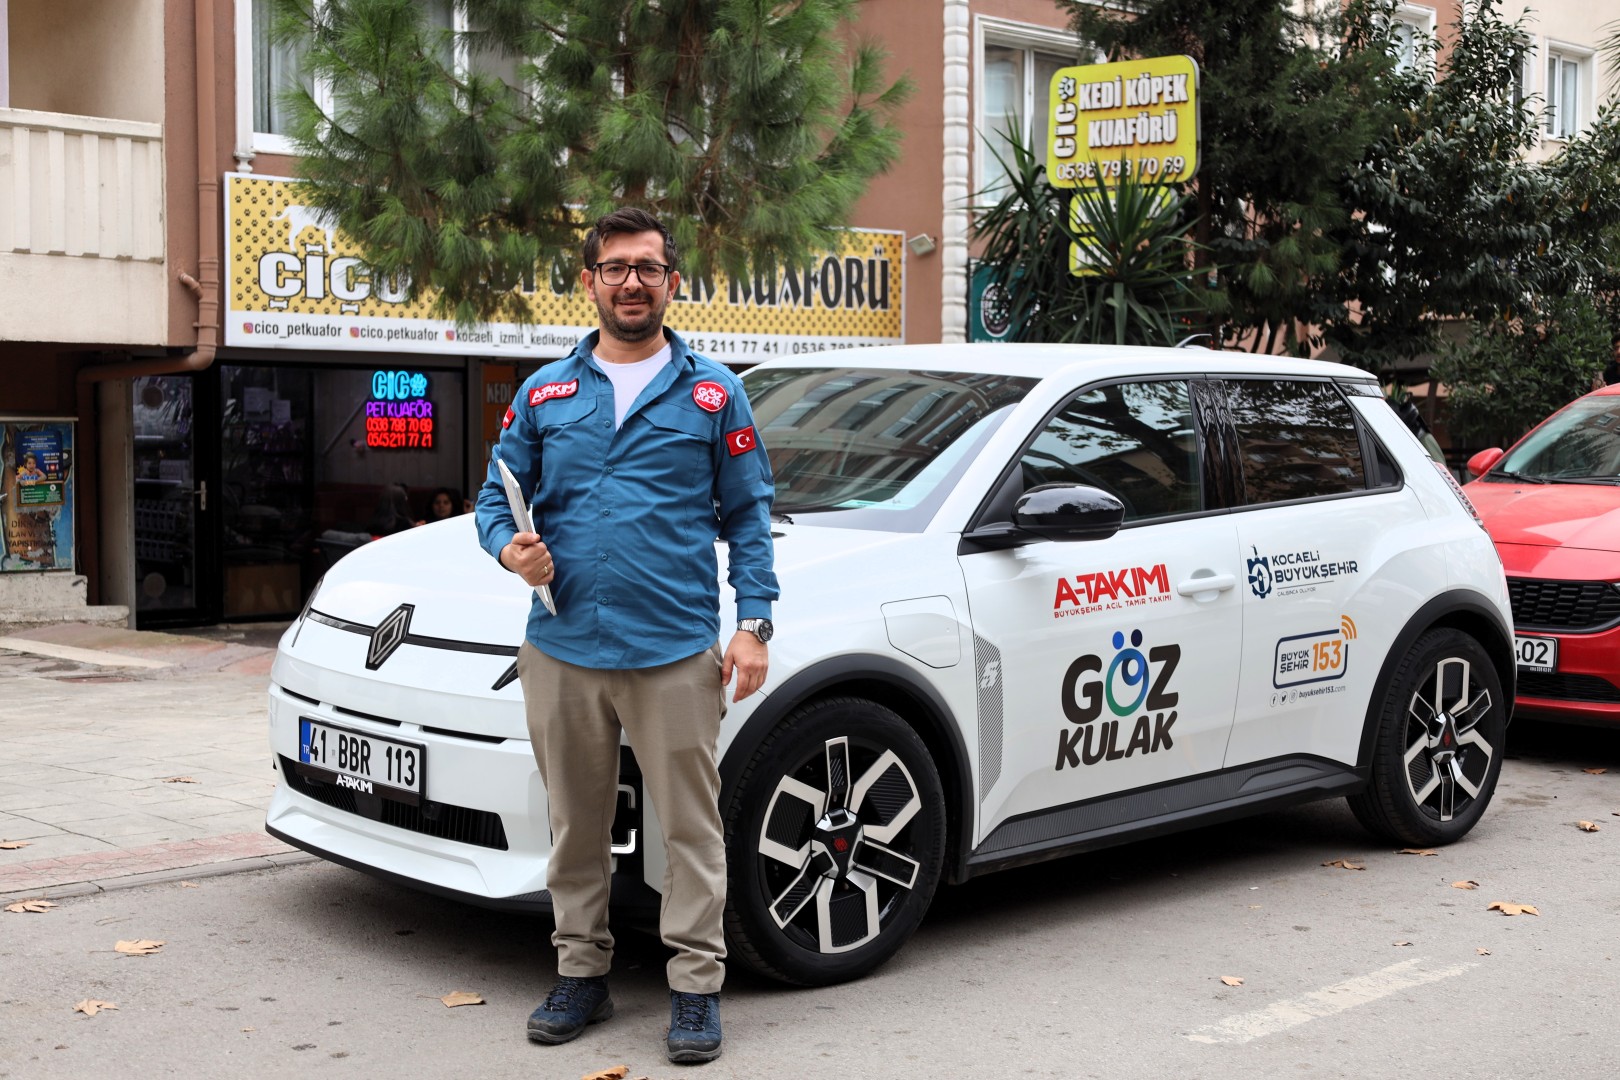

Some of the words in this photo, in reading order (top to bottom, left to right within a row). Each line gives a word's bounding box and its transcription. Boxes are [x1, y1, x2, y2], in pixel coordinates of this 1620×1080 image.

[1079, 75, 1122, 112] KEDİ
[1126, 72, 1189, 107] KÖPEK
[1088, 109, 1178, 149] KUAFÖRÜ
[254, 321, 343, 339] cico_petkuafor
[360, 325, 439, 342] cico.petkuafor
[710, 339, 735, 353] 211
[742, 340, 758, 354] 77
[763, 341, 779, 354] 41
[366, 401, 386, 417] PET
[387, 399, 432, 418] KUAFÖR
[366, 417, 389, 432] 0536
[389, 417, 407, 433] 798
[407, 417, 419, 433] 70
[420, 417, 433, 433] 69
[407, 432, 420, 447] 77
[1271, 550, 1321, 566] KOCAELİ
[1274, 560, 1359, 583] BÜYÜKŞEHİR
[1053, 564, 1170, 609] A-TAKIMI
[1054, 604, 1103, 618] BÜYÜKŞEHİR
[1125, 598, 1146, 607] TAMİR
[1149, 594, 1172, 603] TAKIMI
[1280, 659, 1309, 674] ŞEHİR
[1281, 649, 1310, 662] BÜYÜK
[1312, 640, 1342, 672] 153
[1061, 629, 1181, 724] GÖZ
[1055, 710, 1178, 771] KULAK
[310, 727, 327, 764] 41
[338, 733, 371, 776] BBR
[386, 745, 416, 786] 113
[336, 774, 373, 795] A-TAKIMI
